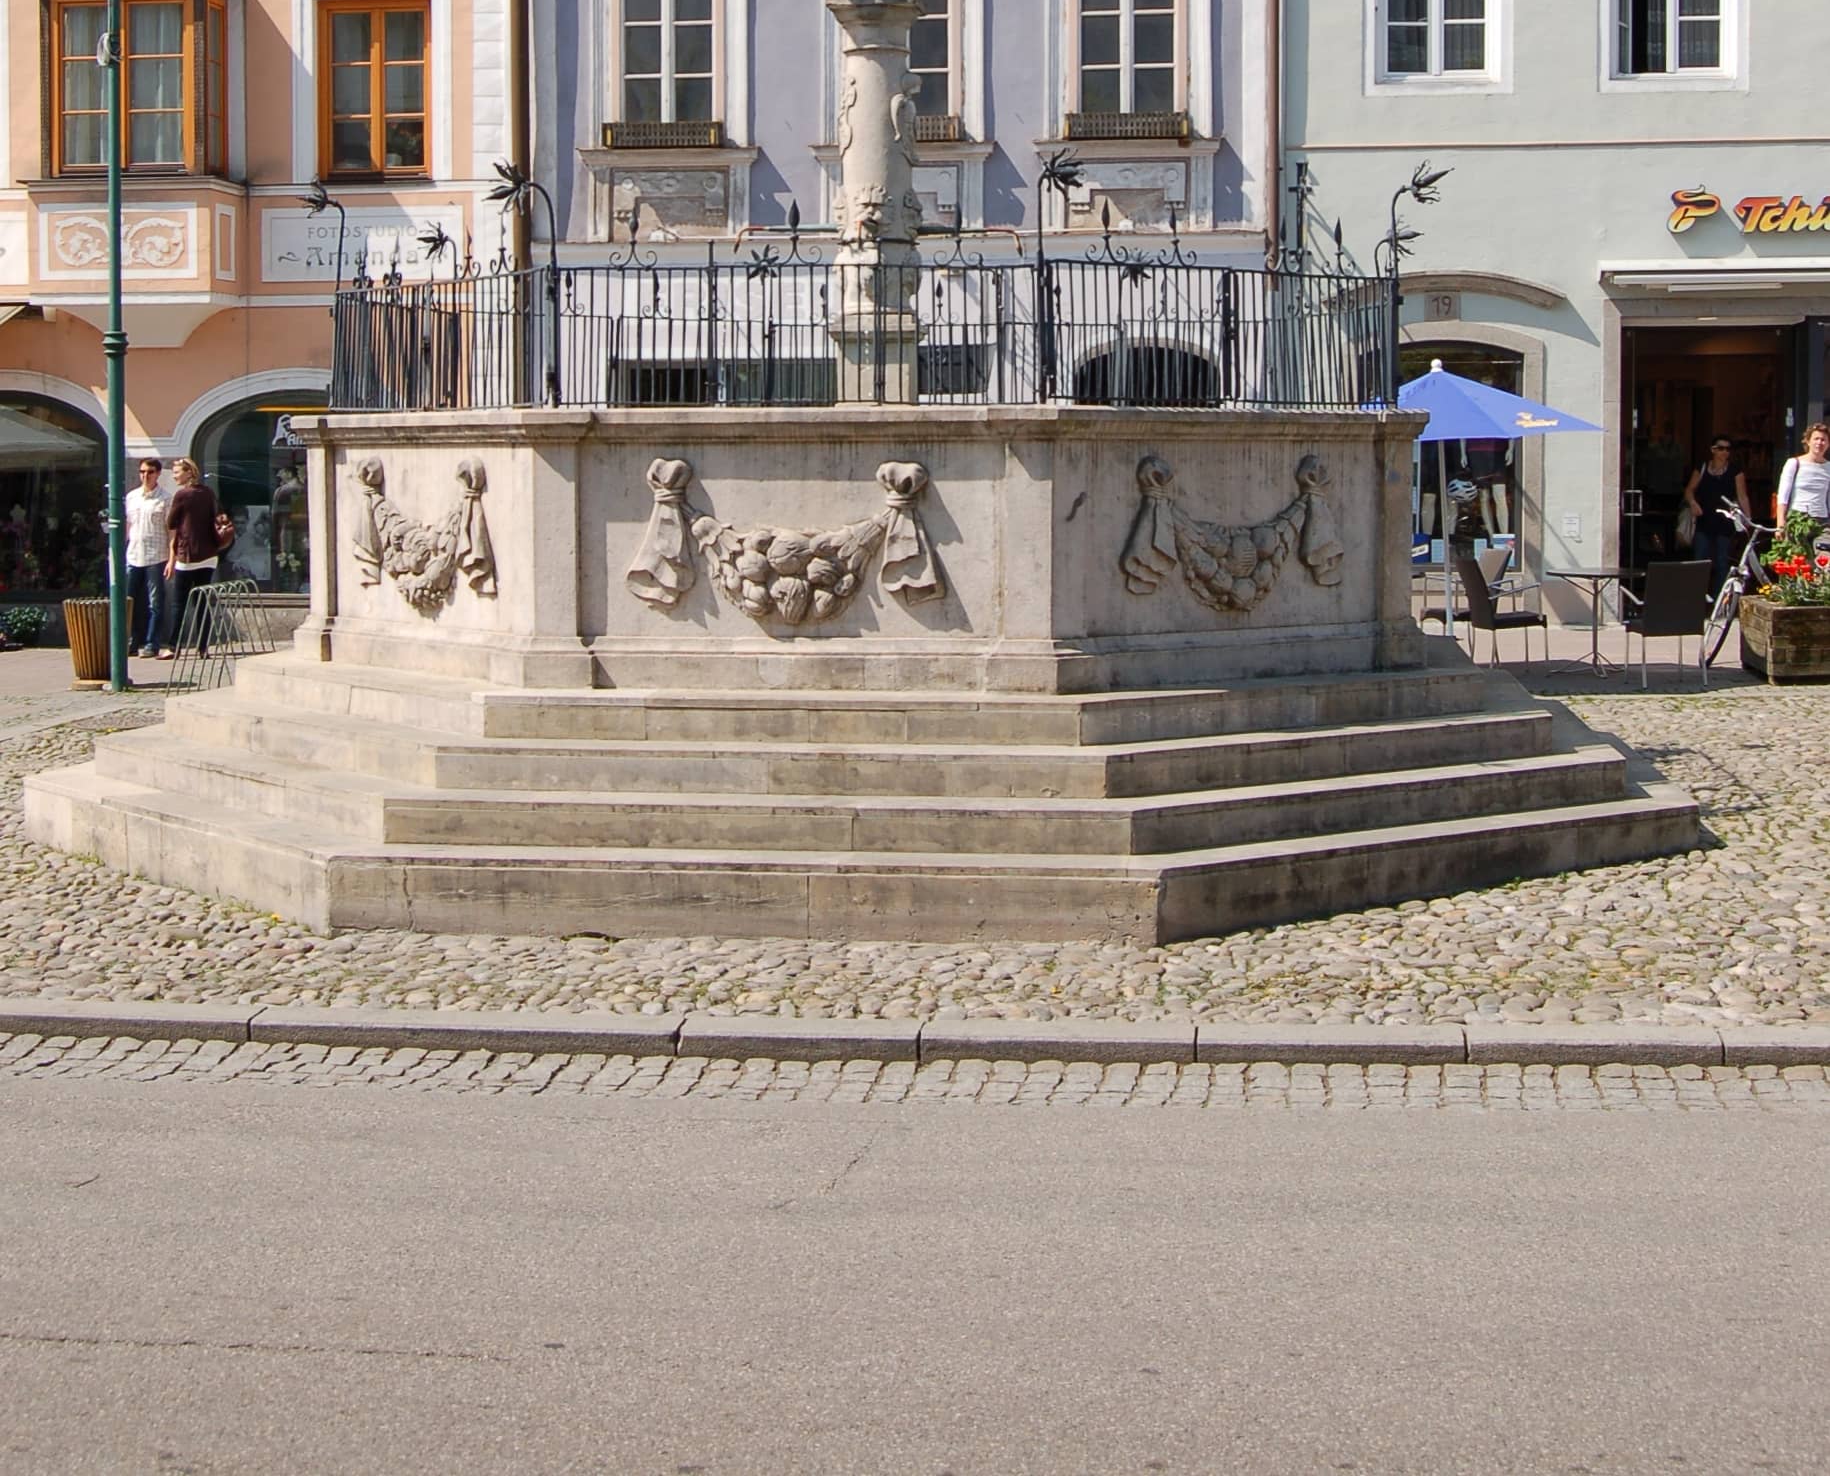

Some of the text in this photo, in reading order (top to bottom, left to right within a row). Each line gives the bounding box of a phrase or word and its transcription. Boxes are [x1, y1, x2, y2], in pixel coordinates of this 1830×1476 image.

[1733, 195, 1830, 232] Tchi
[307, 224, 418, 239] FOTOSTUDIO
[306, 246, 419, 266] Amanda
[1431, 294, 1452, 316] 19
